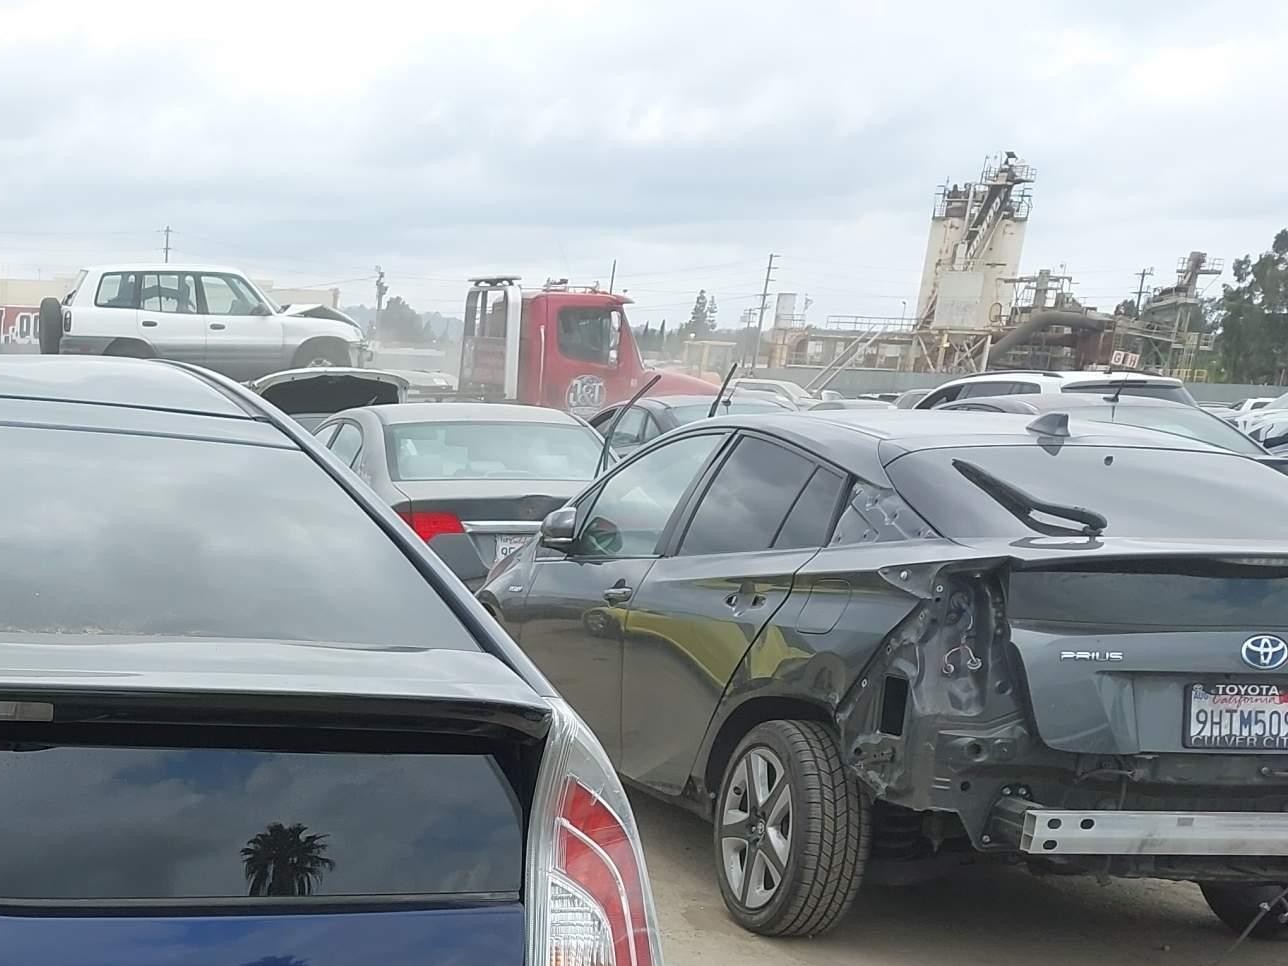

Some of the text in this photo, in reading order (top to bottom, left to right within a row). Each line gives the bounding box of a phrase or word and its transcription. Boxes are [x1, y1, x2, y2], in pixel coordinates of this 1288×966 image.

[1060, 651, 1123, 661] PRIUS
[1215, 684, 1280, 695] TOYOTA
[1192, 736, 1258, 747] CULVER
